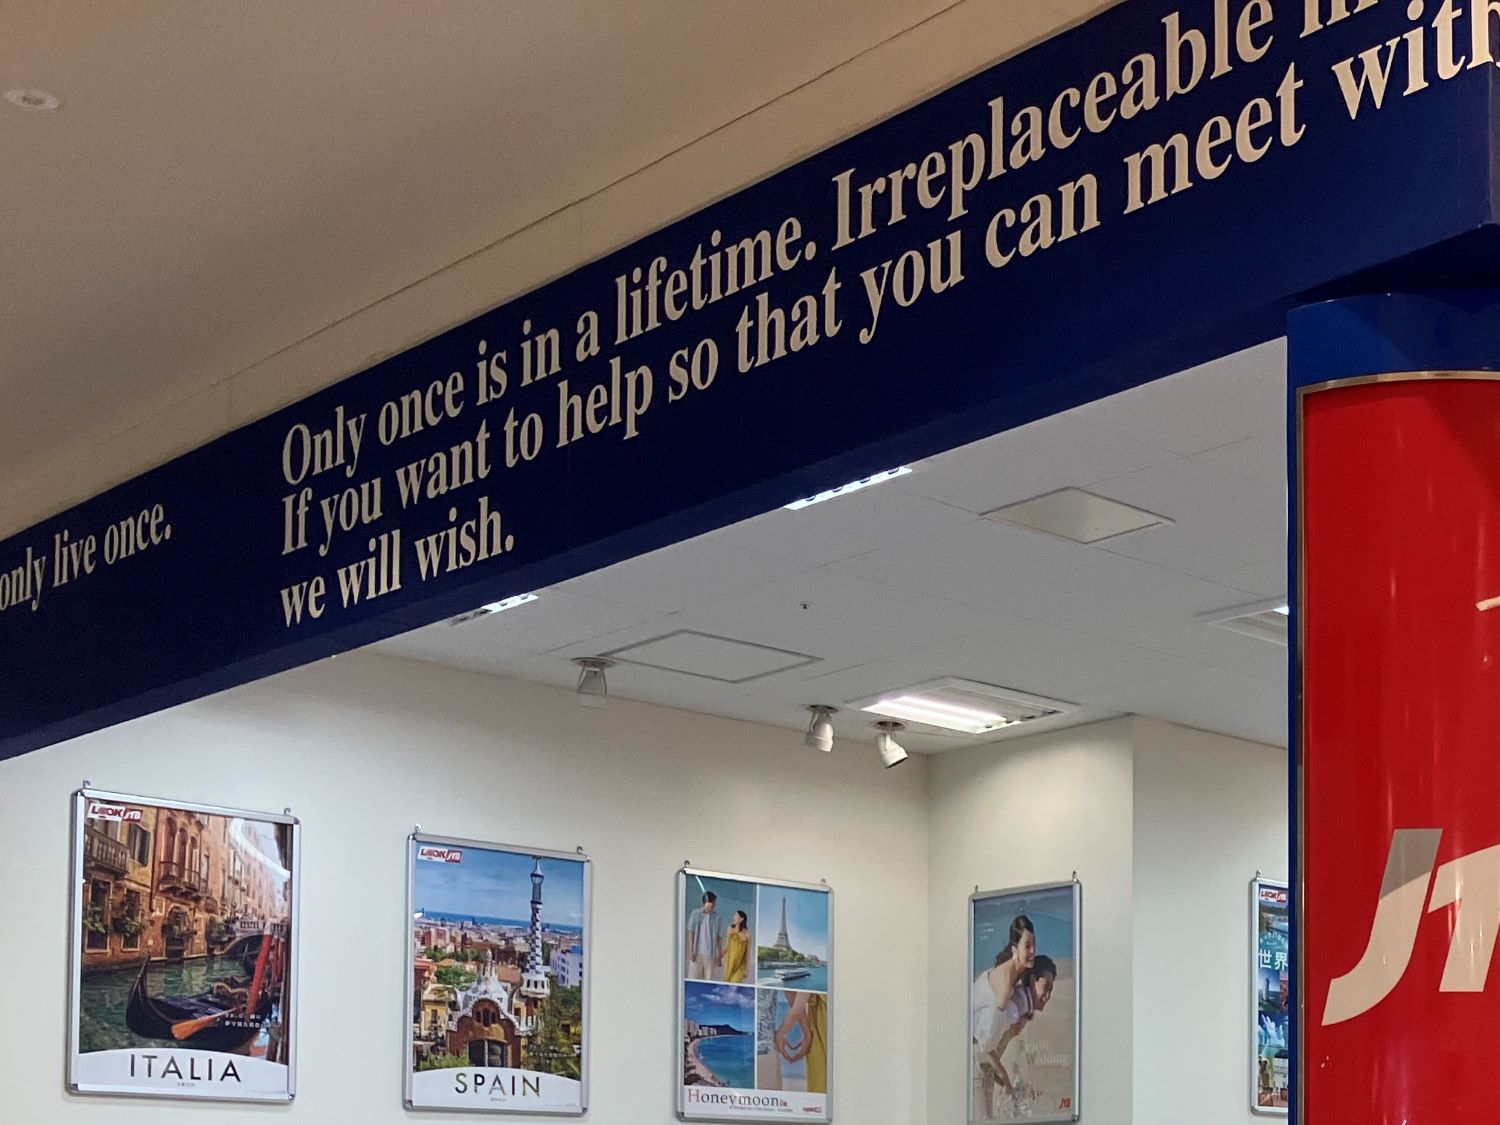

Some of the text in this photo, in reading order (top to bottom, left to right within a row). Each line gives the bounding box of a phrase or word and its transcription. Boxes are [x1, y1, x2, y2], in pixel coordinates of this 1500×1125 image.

[283, 405, 367, 485] Only
[378, 371, 464, 447] once
[477, 341, 508, 406] is
[522, 320, 561, 387] in
[576, 310, 601, 361] a
[615, 217, 818, 347] lifetime.
[832, 0, 1274, 251] Irreplaceable
[282, 492, 312, 557] If
[320, 478, 382, 556] you
[395, 426, 491, 513] want
[504, 410, 544, 463] to
[557, 357, 655, 447] help
[668, 338, 720, 403] so
[735, 268, 842, 374] that
[859, 230, 964, 344] you
[984, 173, 1100, 268] can
[1121, 63, 1307, 216] meet
[53, 529, 97, 588] live
[103, 503, 172, 565] once.
[281, 496, 515, 628] we will wish.
[130, 1053, 242, 1083] ITALIA
[454, 1071, 541, 1098] SPAIN
[687, 1088, 780, 1107] Honeymoon
